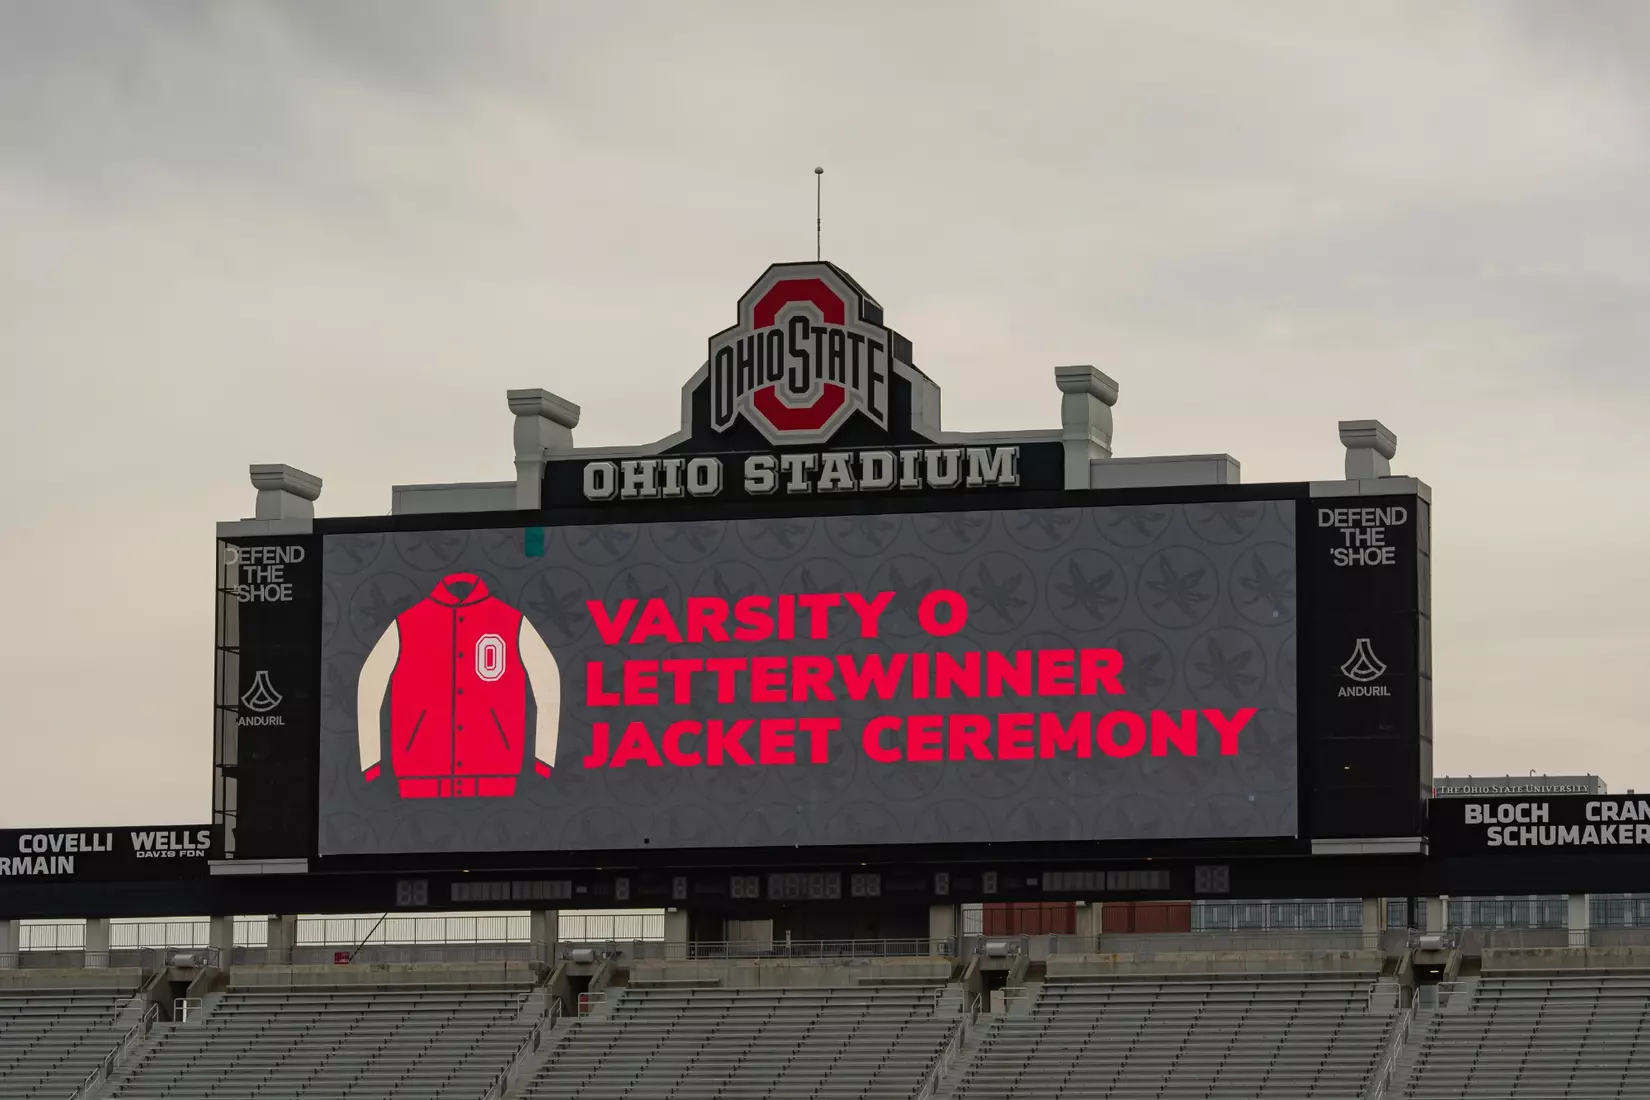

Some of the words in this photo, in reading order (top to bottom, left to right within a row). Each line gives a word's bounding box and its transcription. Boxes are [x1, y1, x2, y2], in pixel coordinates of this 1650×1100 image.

[714, 327, 785, 428] OHIO
[787, 315, 885, 424] STATE
[583, 456, 723, 501] OHIO
[744, 446, 1020, 496] STADIUM
[1317, 506, 1408, 527] DEFEND
[1340, 527, 1386, 547] THE
[224, 545, 305, 565] DEFEND
[1329, 546, 1396, 566] 'SHOE
[243, 565, 284, 583] THE
[585, 591, 897, 646] VARSITY
[917, 589, 969, 637] O
[586, 648, 1127, 708] LETTERWINNER
[1337, 685, 1391, 697] ANDURIL
[237, 715, 286, 726] ANDURIL
[583, 717, 841, 769] JACKET
[861, 707, 1259, 763] CEREMONY
[1464, 802, 1550, 824] BLOCH
[18, 832, 113, 854] COVELLI
[131, 830, 211, 851] WELLS
[1486, 824, 1650, 847] SCHUMAKER
[136, 850, 176, 859] DAVIS
[179, 849, 205, 858] FDN
[0, 855, 75, 876] RMAIN
